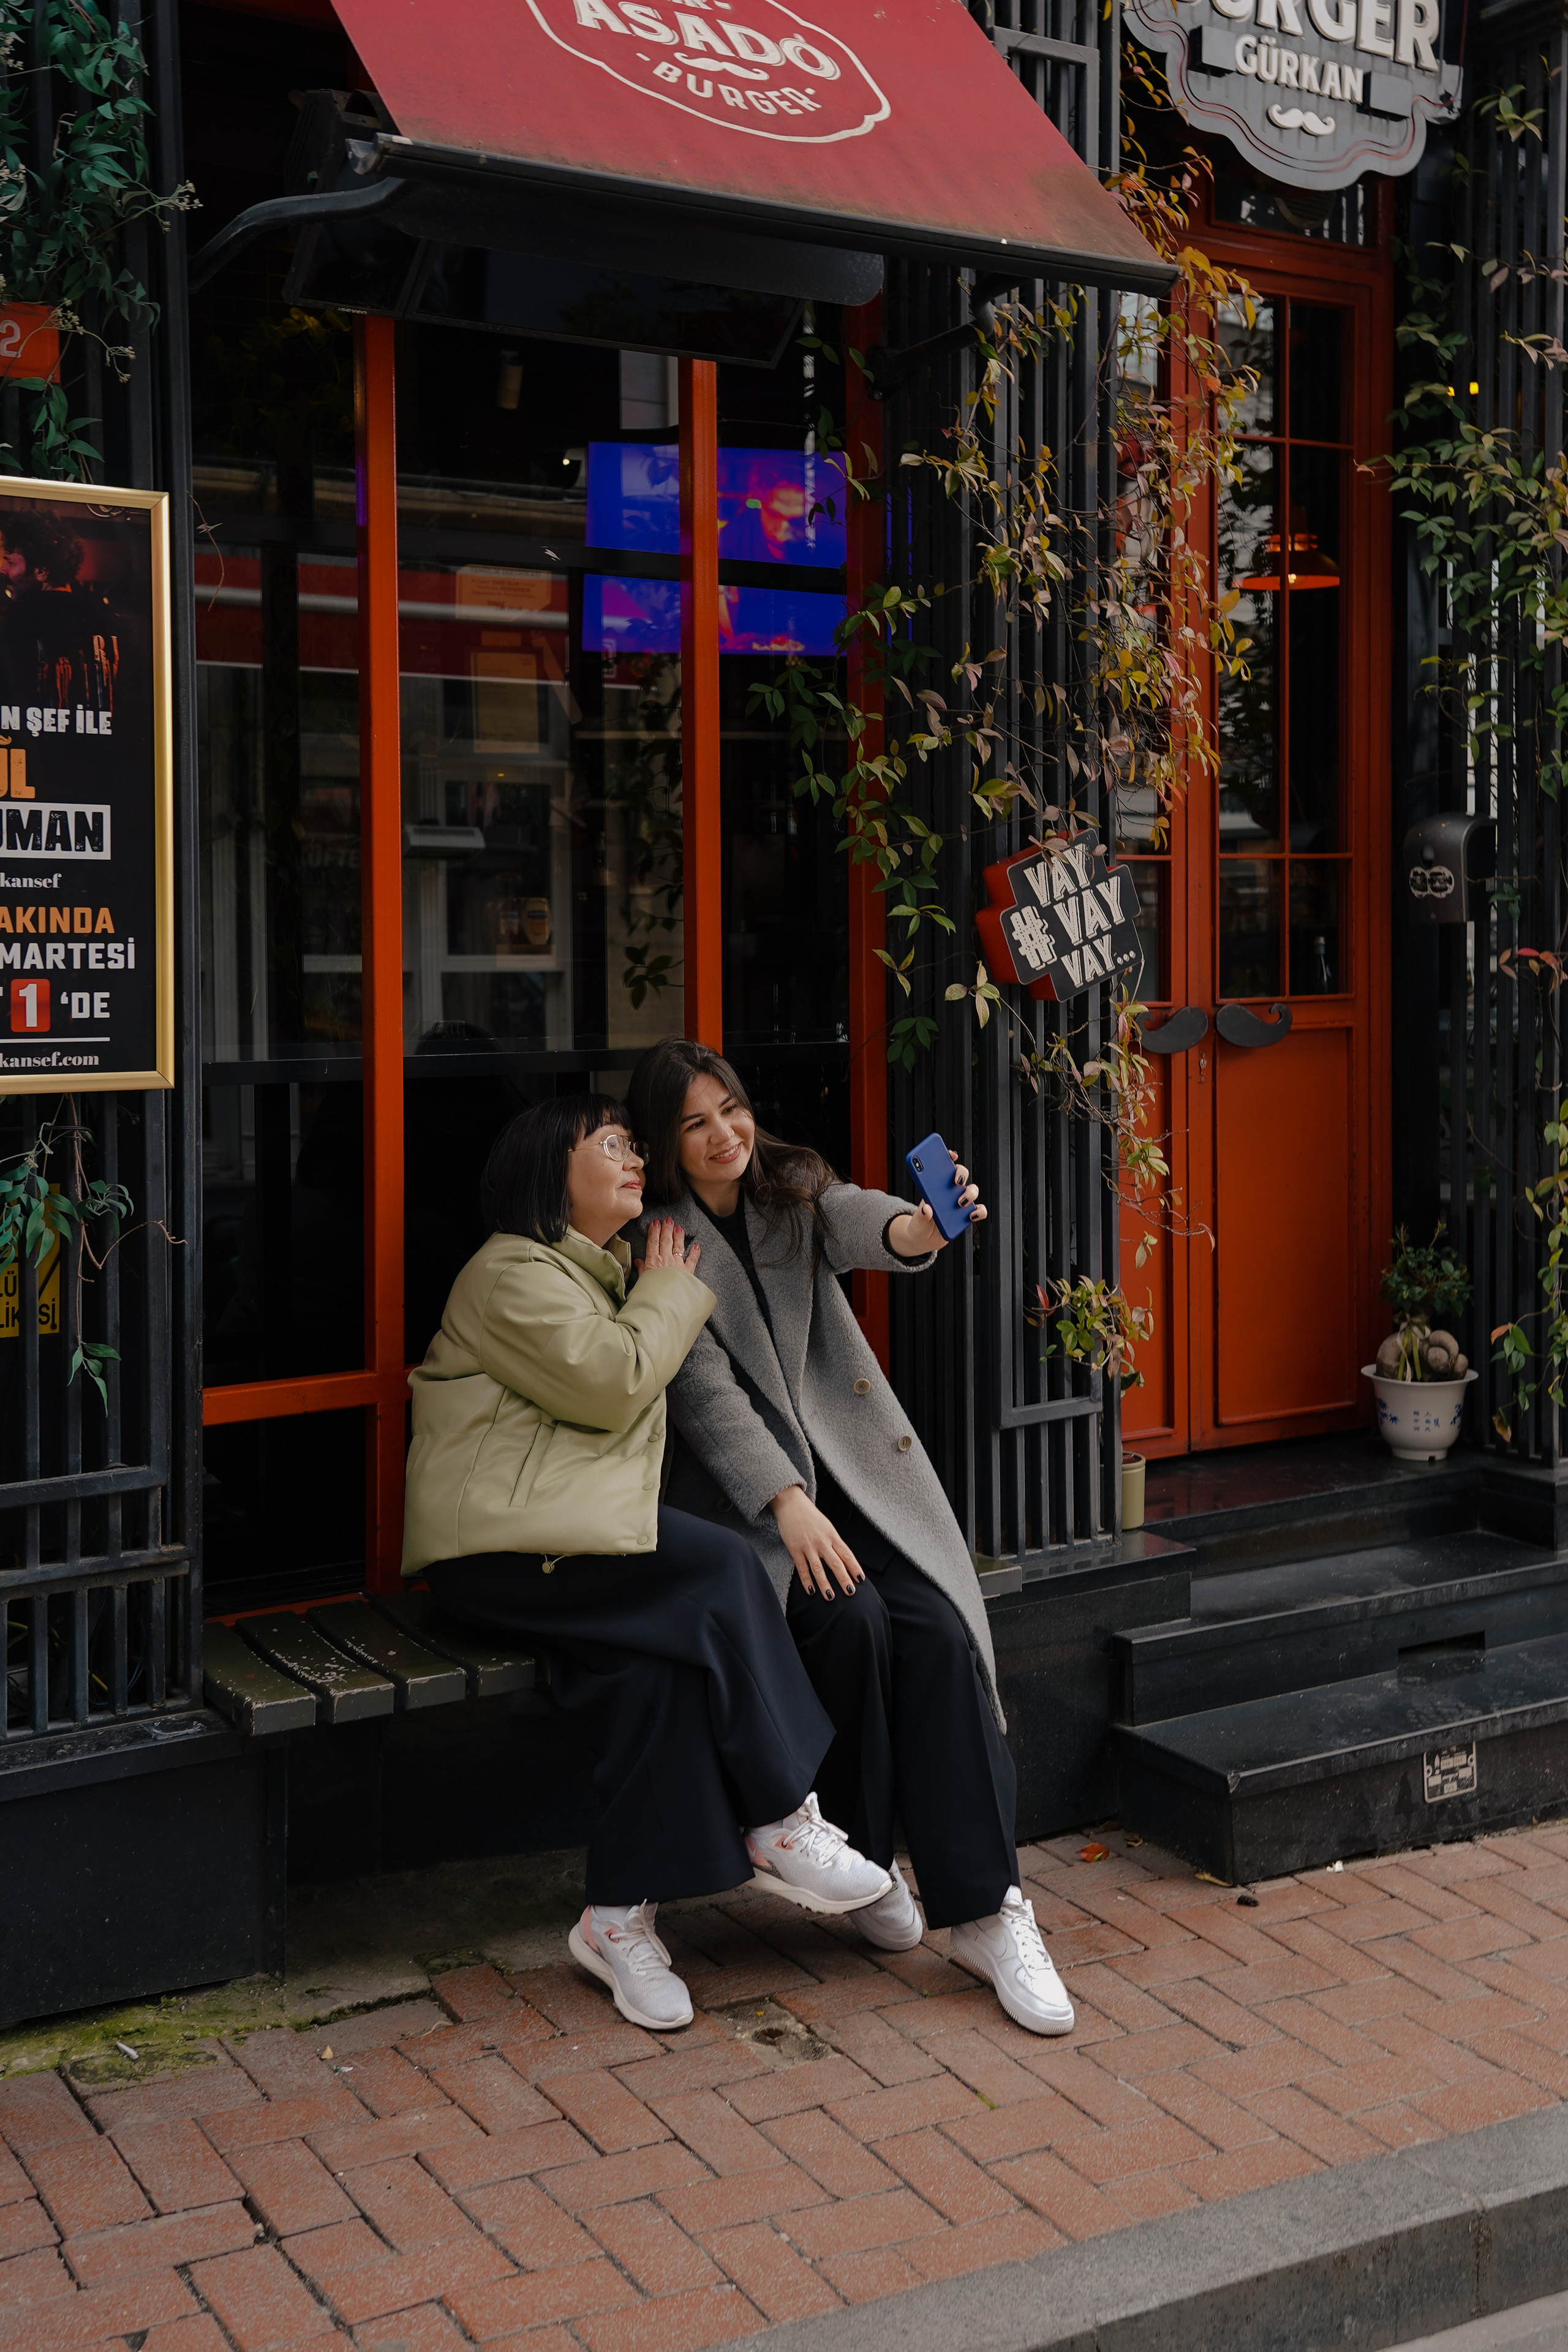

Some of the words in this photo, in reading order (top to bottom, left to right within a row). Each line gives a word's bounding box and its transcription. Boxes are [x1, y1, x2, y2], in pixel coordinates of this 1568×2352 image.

[1176, 0, 1439, 72] GER
[1235, 34, 1363, 104] GÜRKAN
[0, 319, 21, 358] 2
[26, 707, 70, 737] ŞEF
[76, 704, 113, 735] İLE
[0, 809, 104, 853] MAN
[0, 872, 62, 888] kansef
[1023, 843, 1090, 908] VAY
[0, 907, 115, 933] AKINDA
[1053, 875, 1125, 946] VAY
[0, 937, 135, 970] MARTESİ
[18, 983, 37, 1027] 1
[0, 1051, 99, 1068] kansef.com
